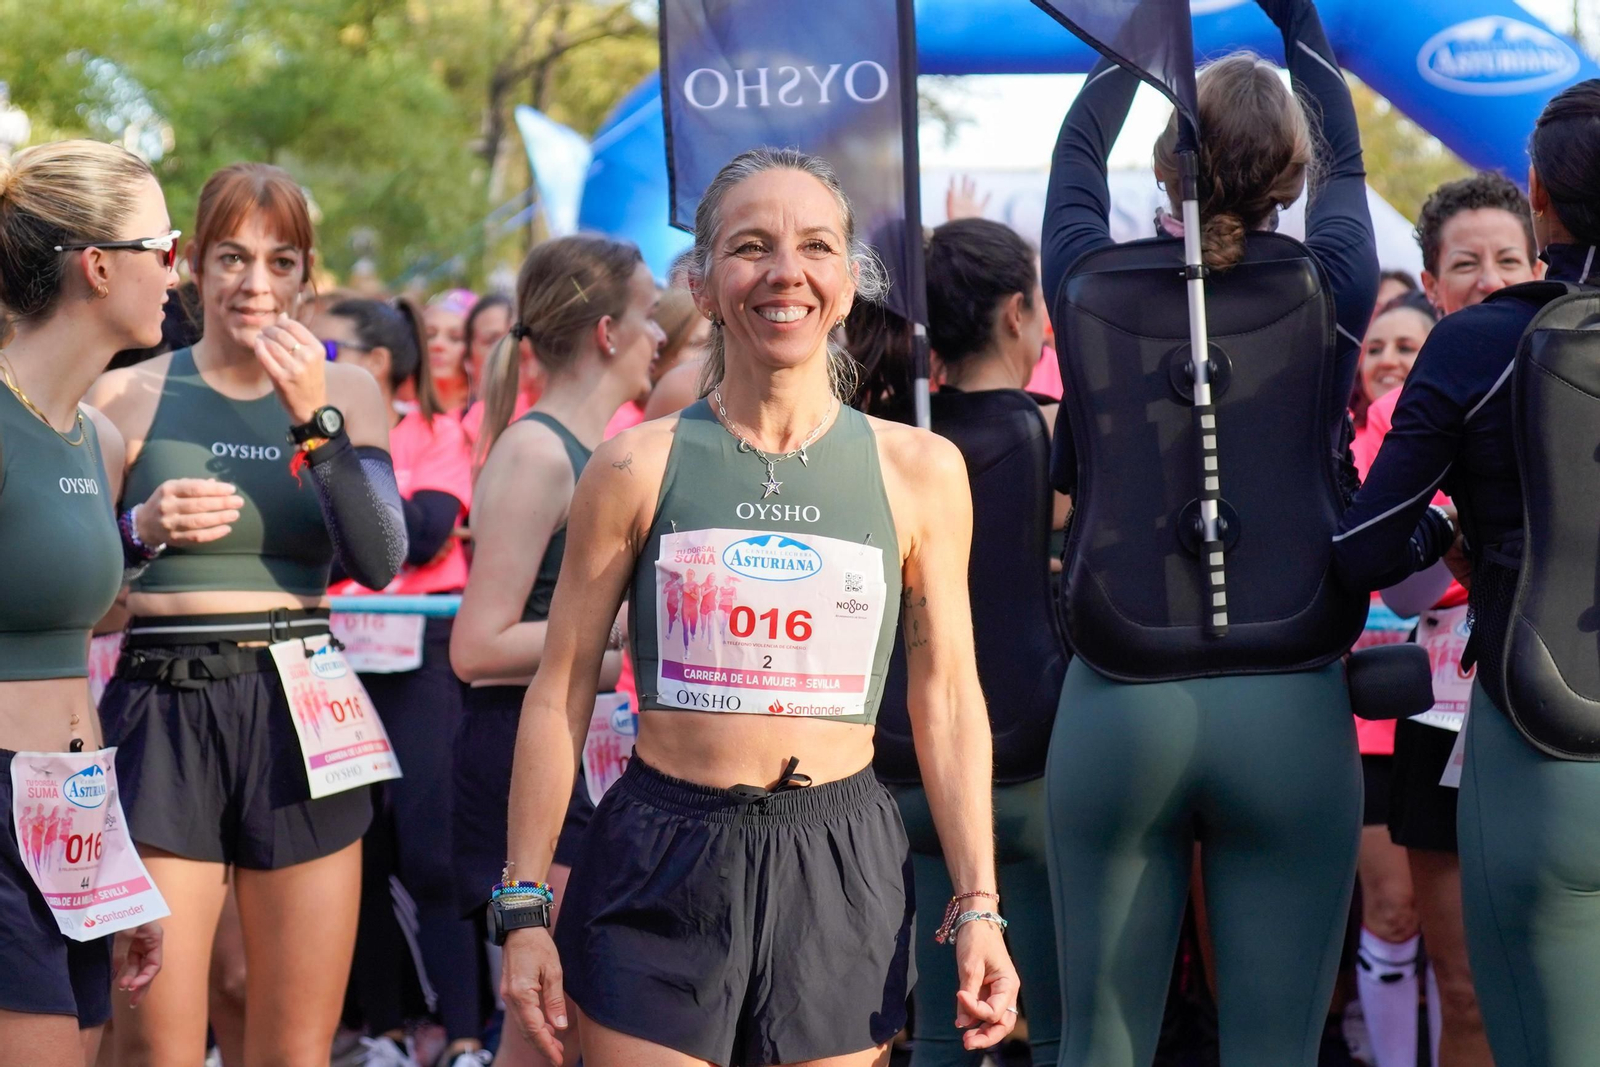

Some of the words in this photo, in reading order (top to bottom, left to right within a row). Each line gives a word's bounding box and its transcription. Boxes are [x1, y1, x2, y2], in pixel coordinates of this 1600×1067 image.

[211, 441, 281, 461] OYSHO
[59, 477, 99, 495] OYSHO
[736, 502, 821, 523] OYSHO
[674, 553, 716, 565] SUMA
[687, 546, 716, 554] DORSAL
[729, 548, 815, 571] ASTURIANA
[729, 605, 813, 642] 016
[762, 655, 772, 669] 2
[683, 668, 728, 682] CARRERA
[730, 675, 743, 684] DE
[746, 676, 759, 685] LA
[762, 677, 796, 688] MUJER
[806, 678, 841, 689] SEVILLA
[330, 696, 364, 723] 016
[676, 689, 741, 711] OYSHO
[786, 702, 845, 715] Santander
[325, 764, 362, 784] OYSHO
[28, 787, 59, 798] SUMA
[65, 832, 102, 864] 016
[80, 876, 90, 889] 44
[97, 885, 129, 900] SEVILLA
[95, 904, 145, 925] Santander
